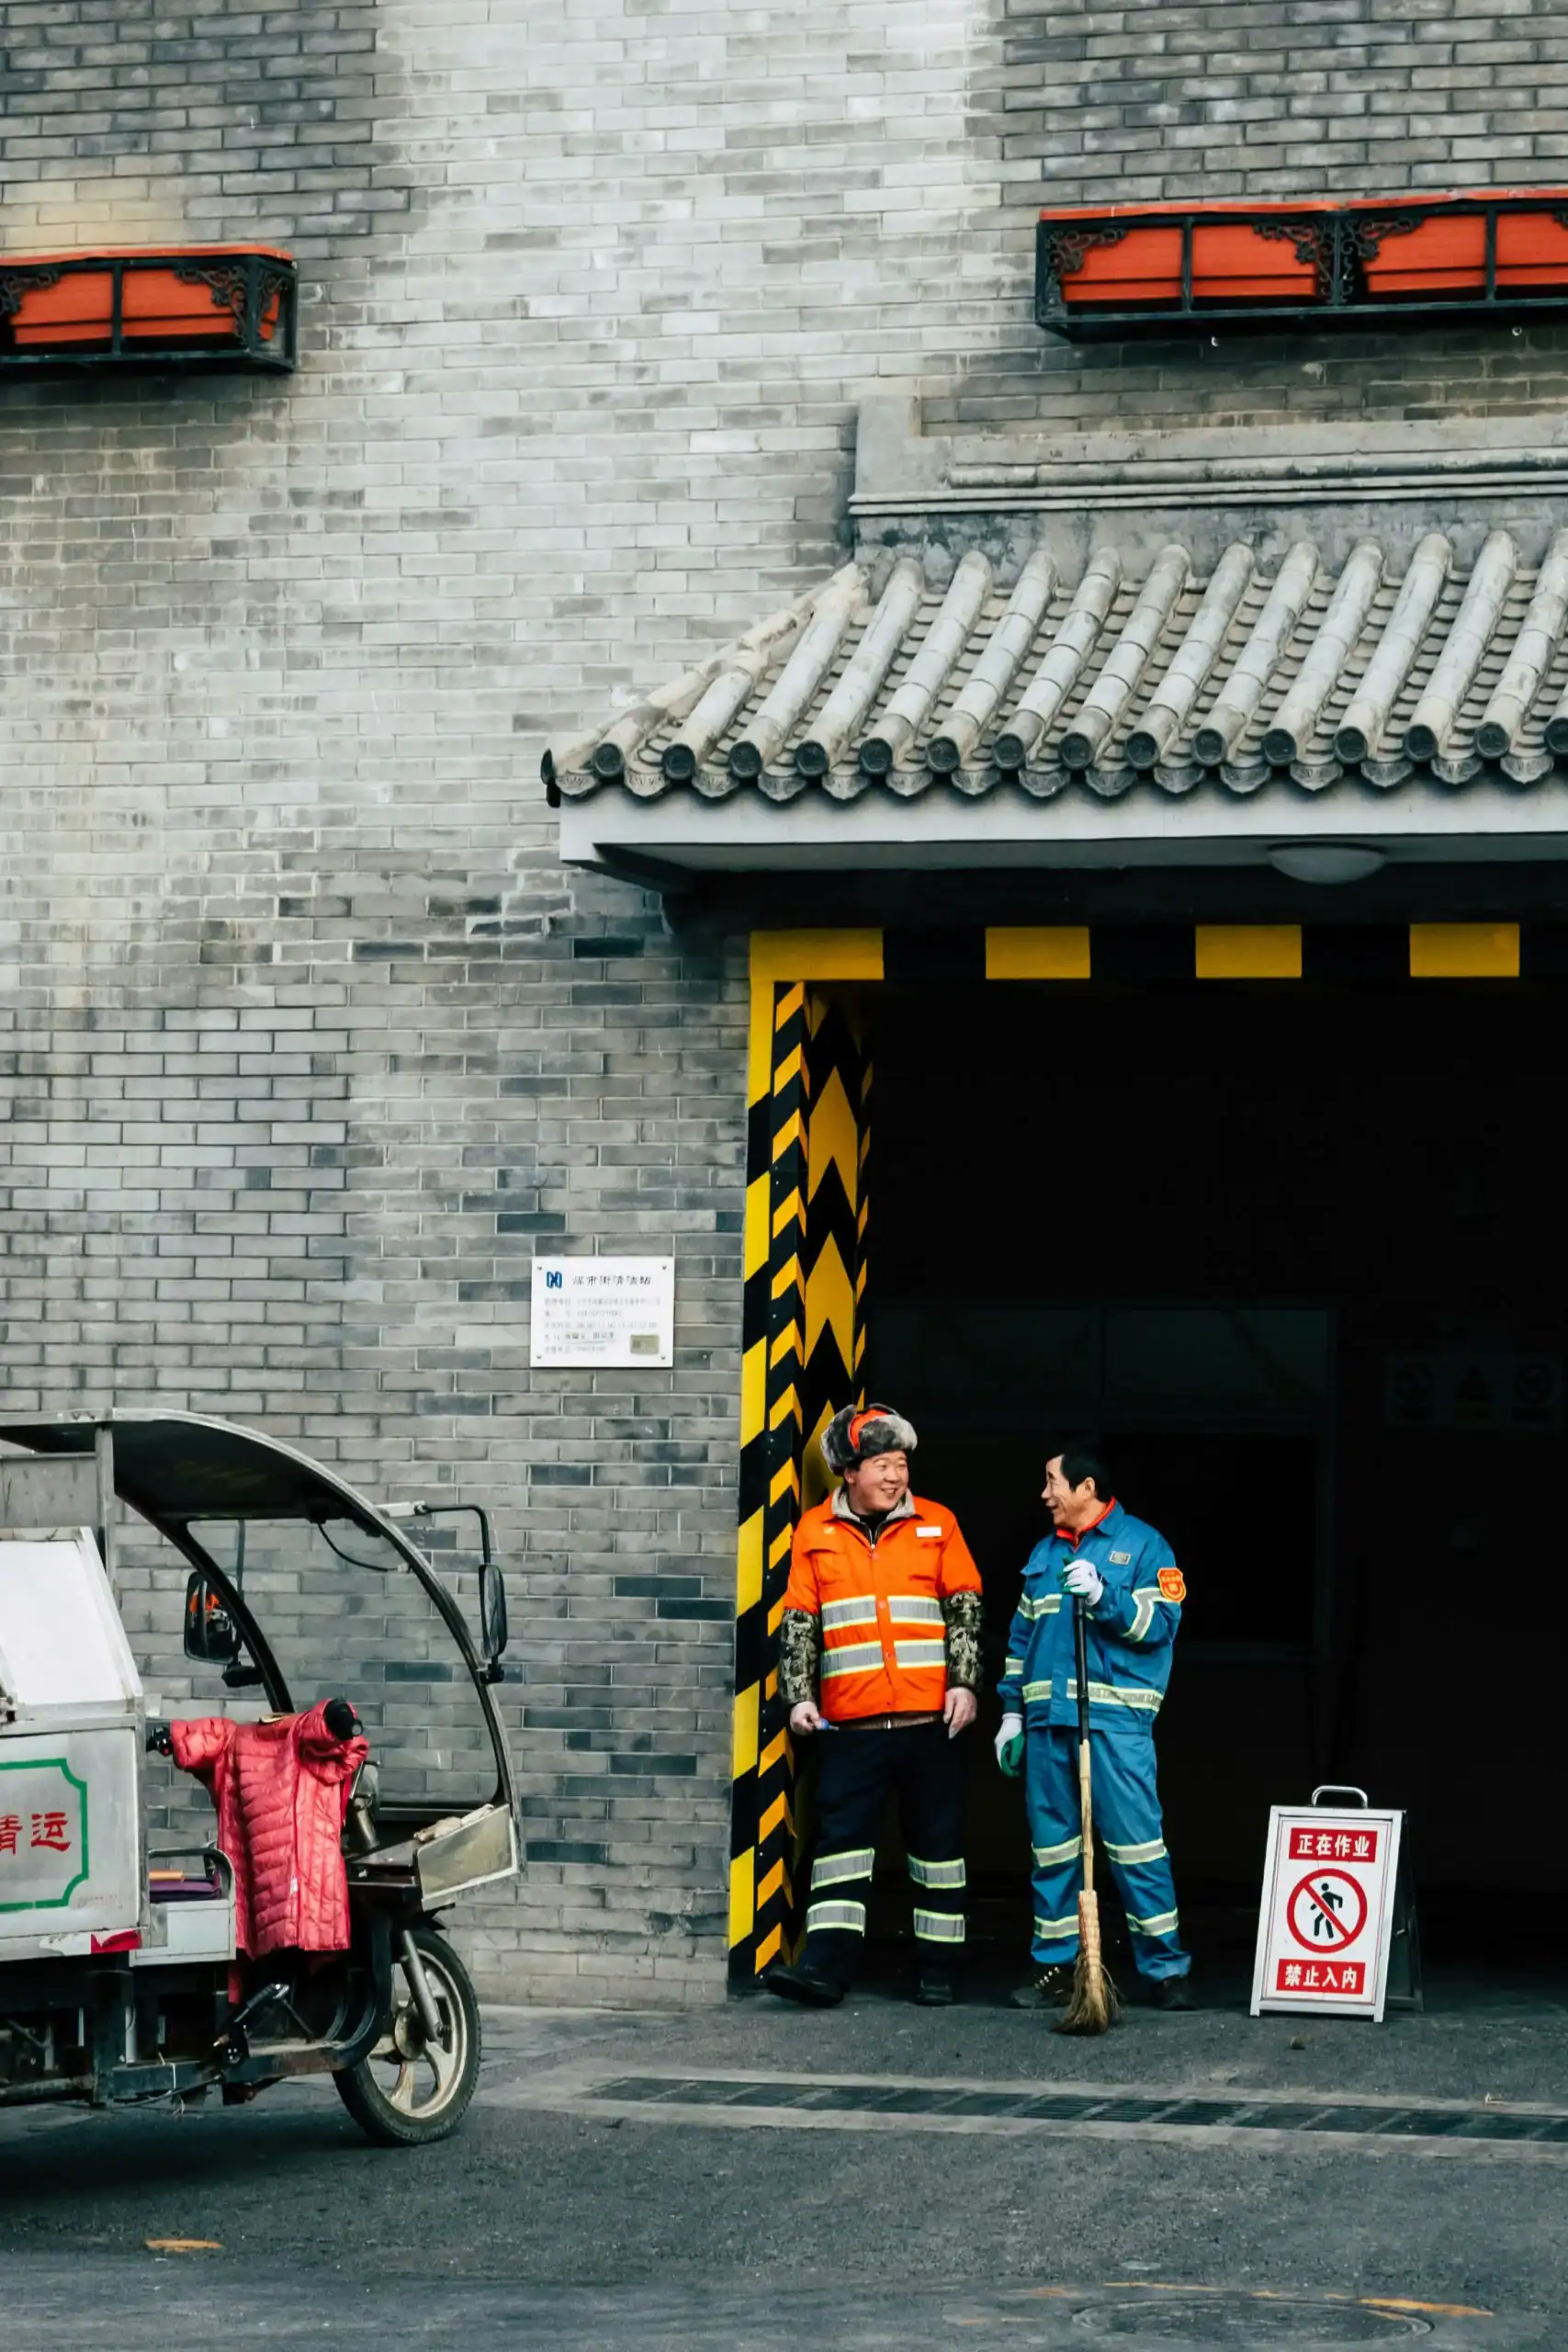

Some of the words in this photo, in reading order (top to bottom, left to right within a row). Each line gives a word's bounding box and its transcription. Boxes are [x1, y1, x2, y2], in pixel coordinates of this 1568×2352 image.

[1297, 1834, 1370, 1858] 正在作业
[1285, 1963, 1357, 1989] 禁止入内
